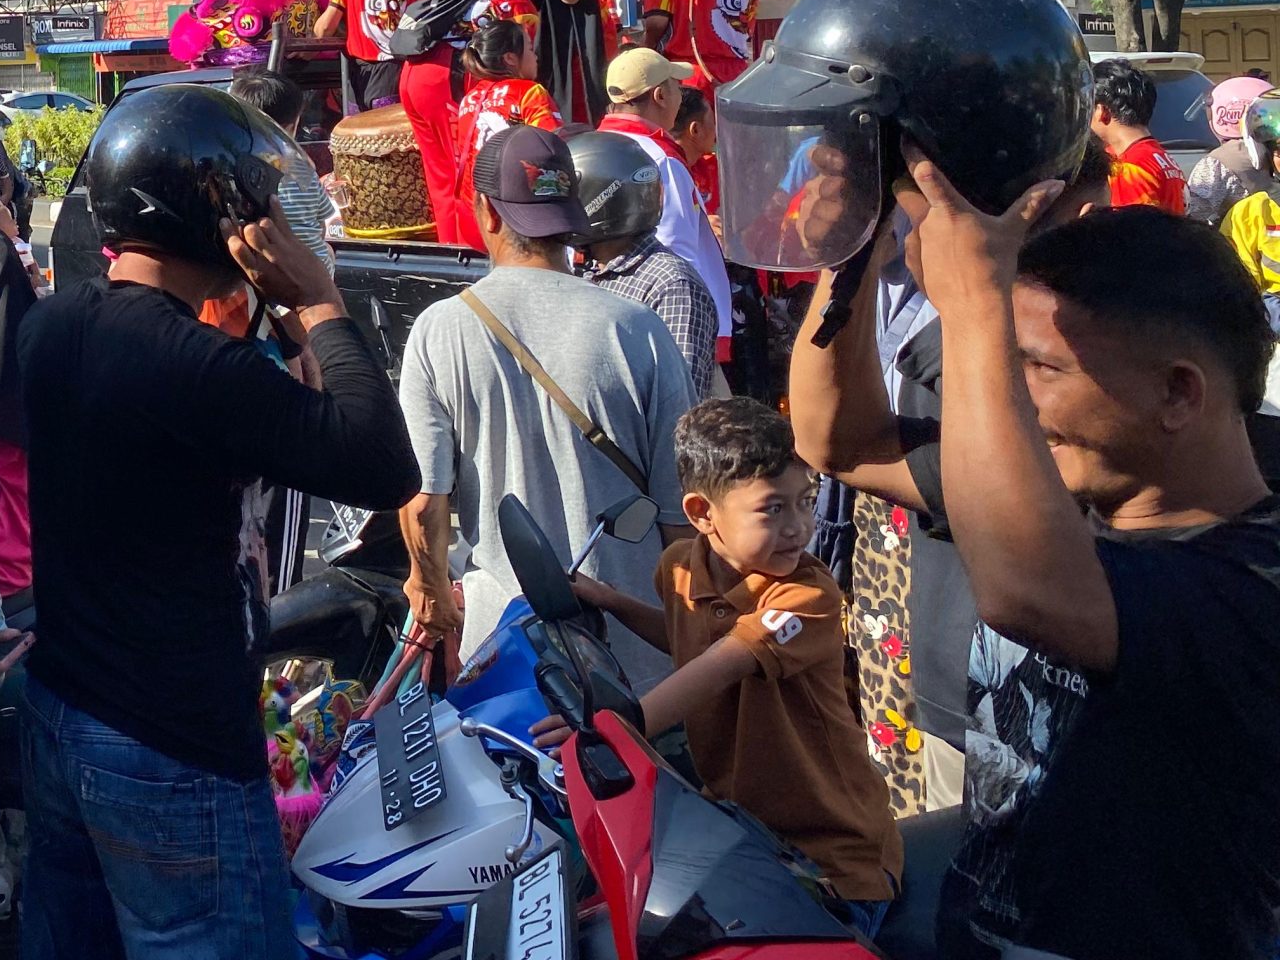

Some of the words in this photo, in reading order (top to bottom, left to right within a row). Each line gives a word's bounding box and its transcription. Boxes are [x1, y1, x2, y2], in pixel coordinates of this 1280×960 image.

[57, 20, 84, 28] Infinix
[398, 682, 425, 717] BL
[402, 712, 434, 760] 1211
[468, 862, 523, 884] YAMA
[518, 861, 551, 901] BL
